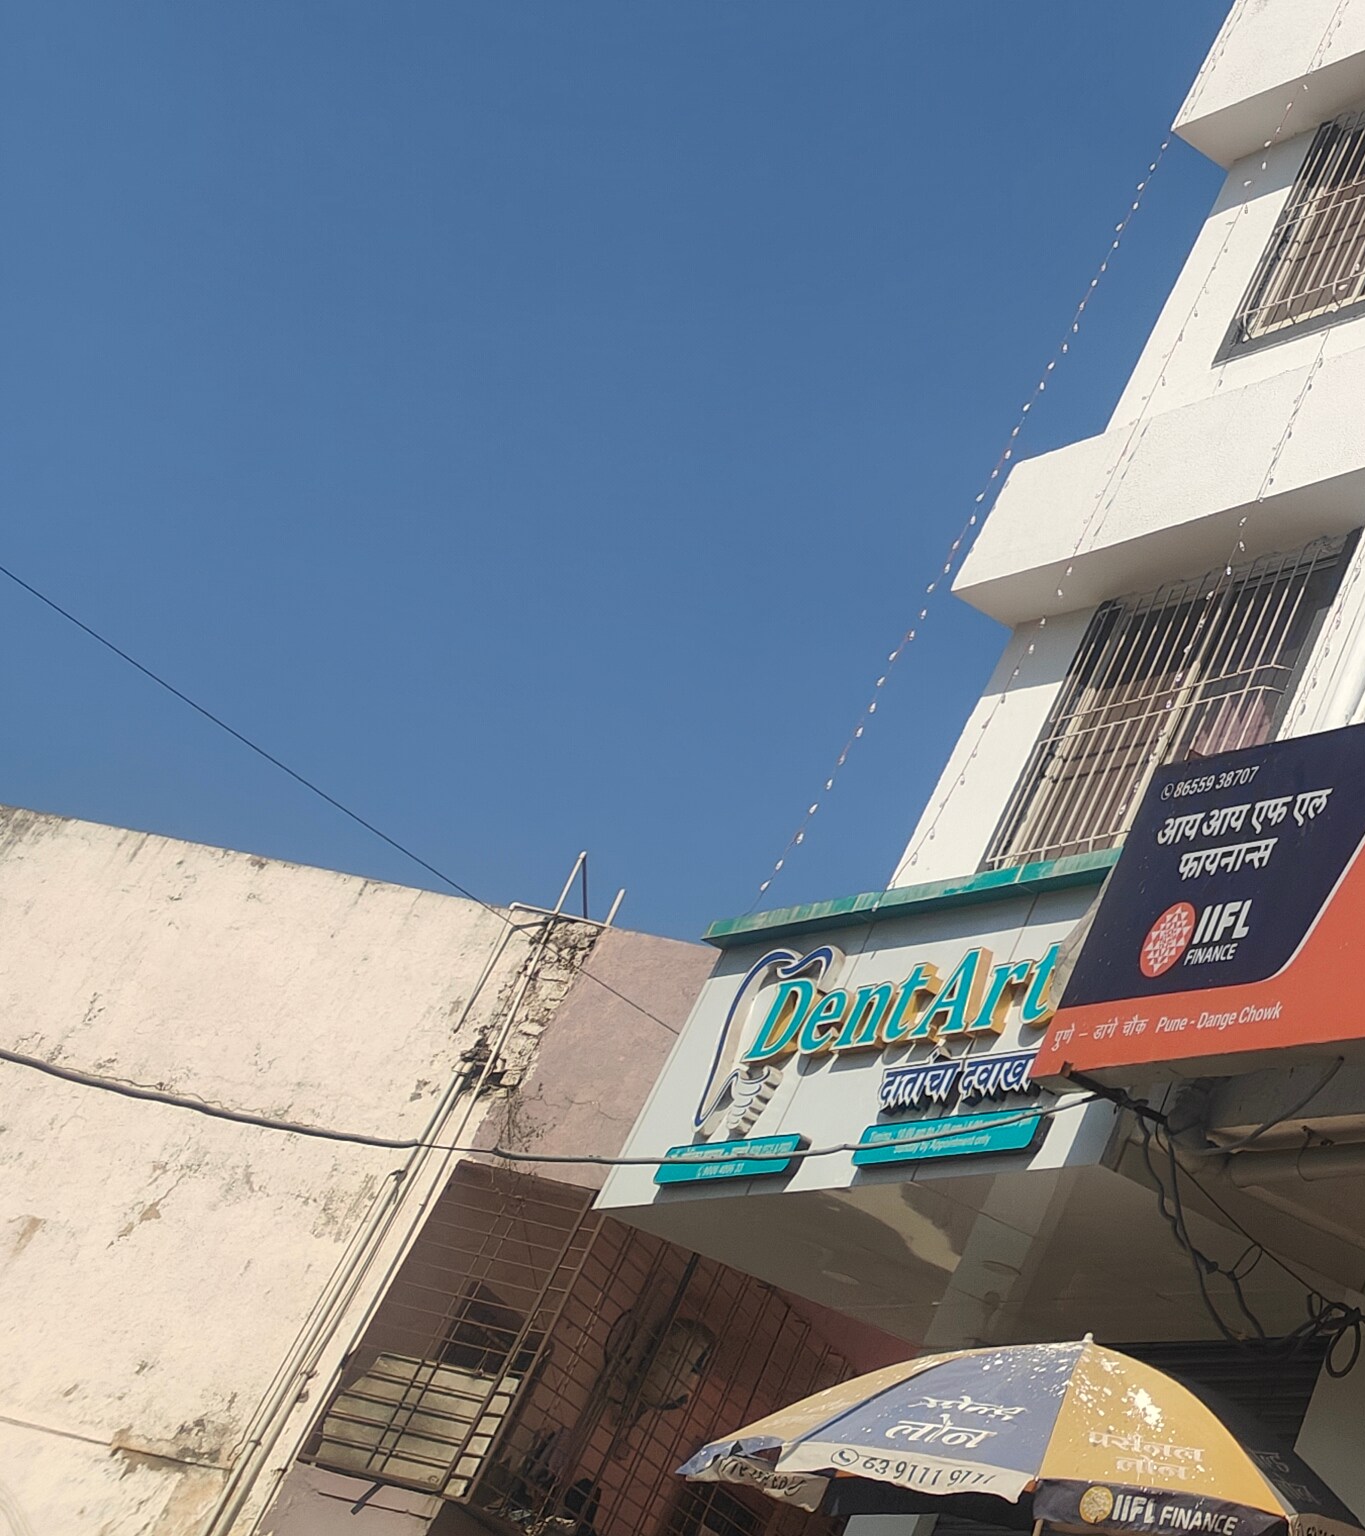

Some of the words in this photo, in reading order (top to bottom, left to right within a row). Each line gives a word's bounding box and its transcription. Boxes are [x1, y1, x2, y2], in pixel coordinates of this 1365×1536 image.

[1173, 774, 1216, 798] 86559
[1215, 766, 1260, 790] 38707
[1157, 812, 1206, 845] आय
[1202, 803, 1252, 836] आय
[1250, 795, 1294, 835] एफ
[1292, 788, 1334, 827] एल
[1178, 837, 1279, 881] फायनान्स
[1191, 899, 1252, 945] IIFL
[1184, 942, 1239, 966] FINANCE
[742, 942, 1062, 1062] DentArt
[1155, 1016, 1187, 1034] Pune
[1196, 1010, 1237, 1031] Dange
[1238, 1001, 1283, 1022] Chowk
[1051, 1021, 1076, 1052] पुणे
[1093, 1019, 1119, 1040] डांगे
[1122, 1014, 1148, 1037] चौक
[1111, 1494, 1158, 1524] IIFL
[1158, 1506, 1239, 1536] FINANCE
